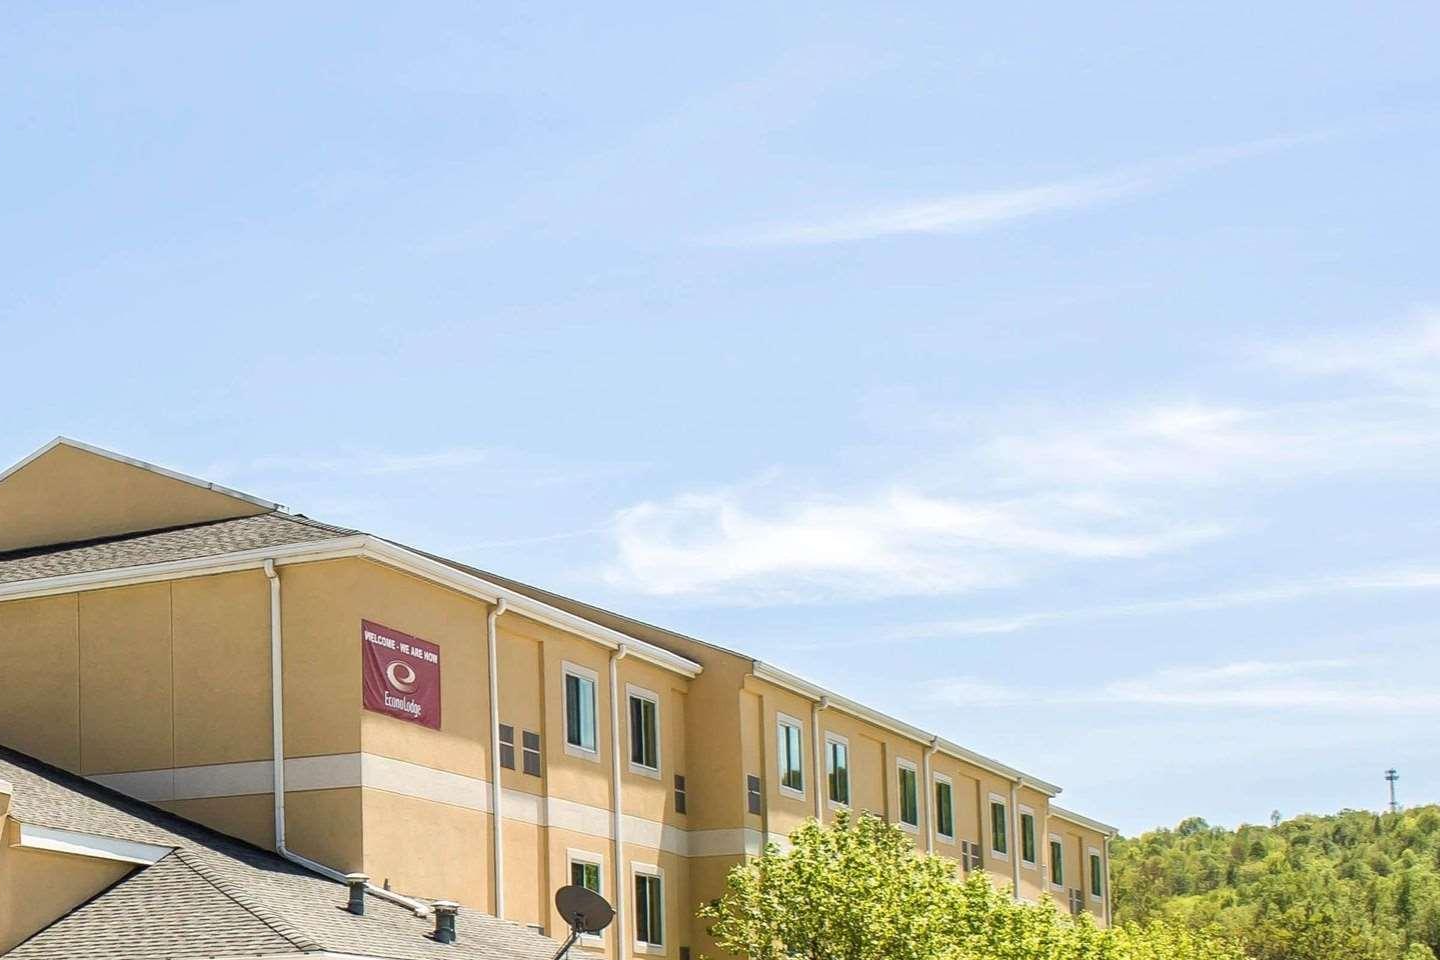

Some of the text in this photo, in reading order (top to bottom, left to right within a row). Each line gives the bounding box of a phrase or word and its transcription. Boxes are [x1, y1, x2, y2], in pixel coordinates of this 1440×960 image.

[364, 630, 396, 650] WELCOME
[400, 643, 409, 654] WE
[411, 646, 423, 659] ARE
[384, 691, 421, 717] EconoLodge
